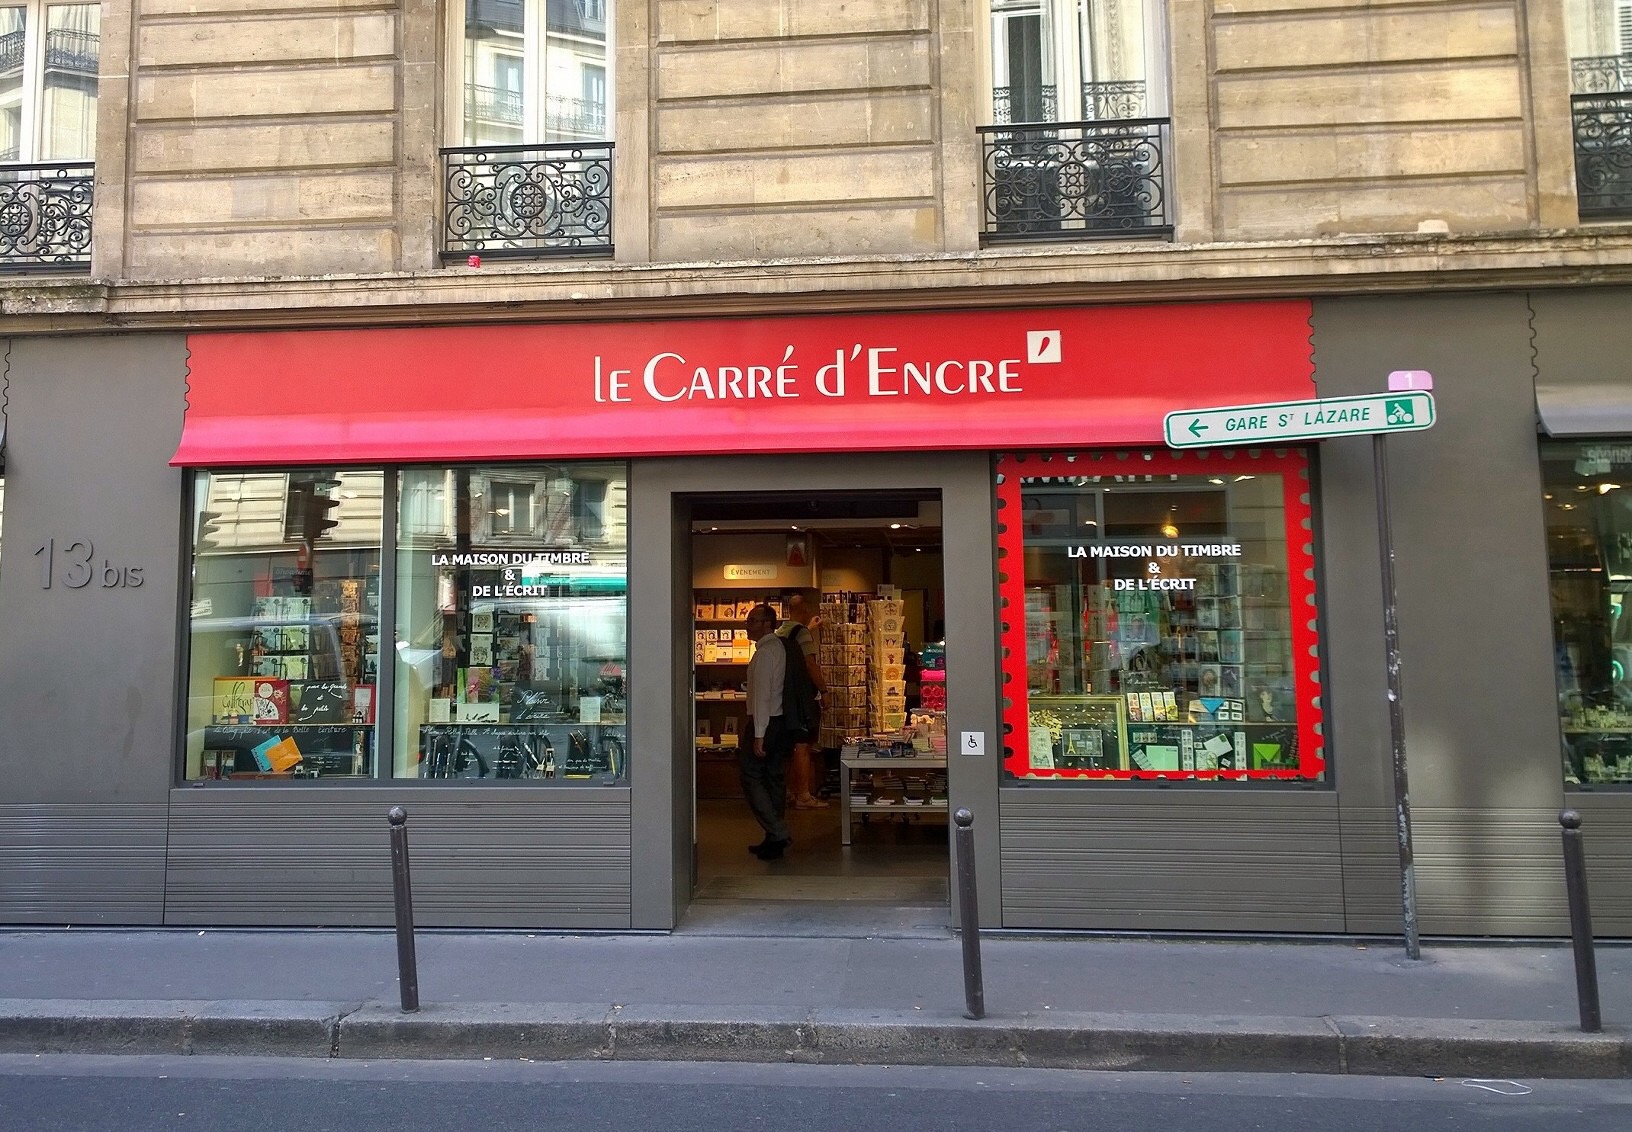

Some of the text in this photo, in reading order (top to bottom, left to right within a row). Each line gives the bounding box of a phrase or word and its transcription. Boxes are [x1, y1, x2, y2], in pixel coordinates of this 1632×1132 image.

[643, 344, 800, 402] CARRÉ
[1404, 372, 1413, 389] 1
[1225, 415, 1268, 432] GARE
[1304, 407, 1371, 426] LAZARE
[1067, 544, 1242, 558] LA MAISON DU TIMBRE
[34, 537, 145, 590] 13 bis
[431, 552, 590, 566] LA MAISON DU TIMBRE
[504, 569, 516, 581] &
[1148, 562, 1162, 574] &
[472, 582, 548, 597] DE L'ÉCRIT
[1114, 575, 1197, 591] DE L'ÉCRIT
